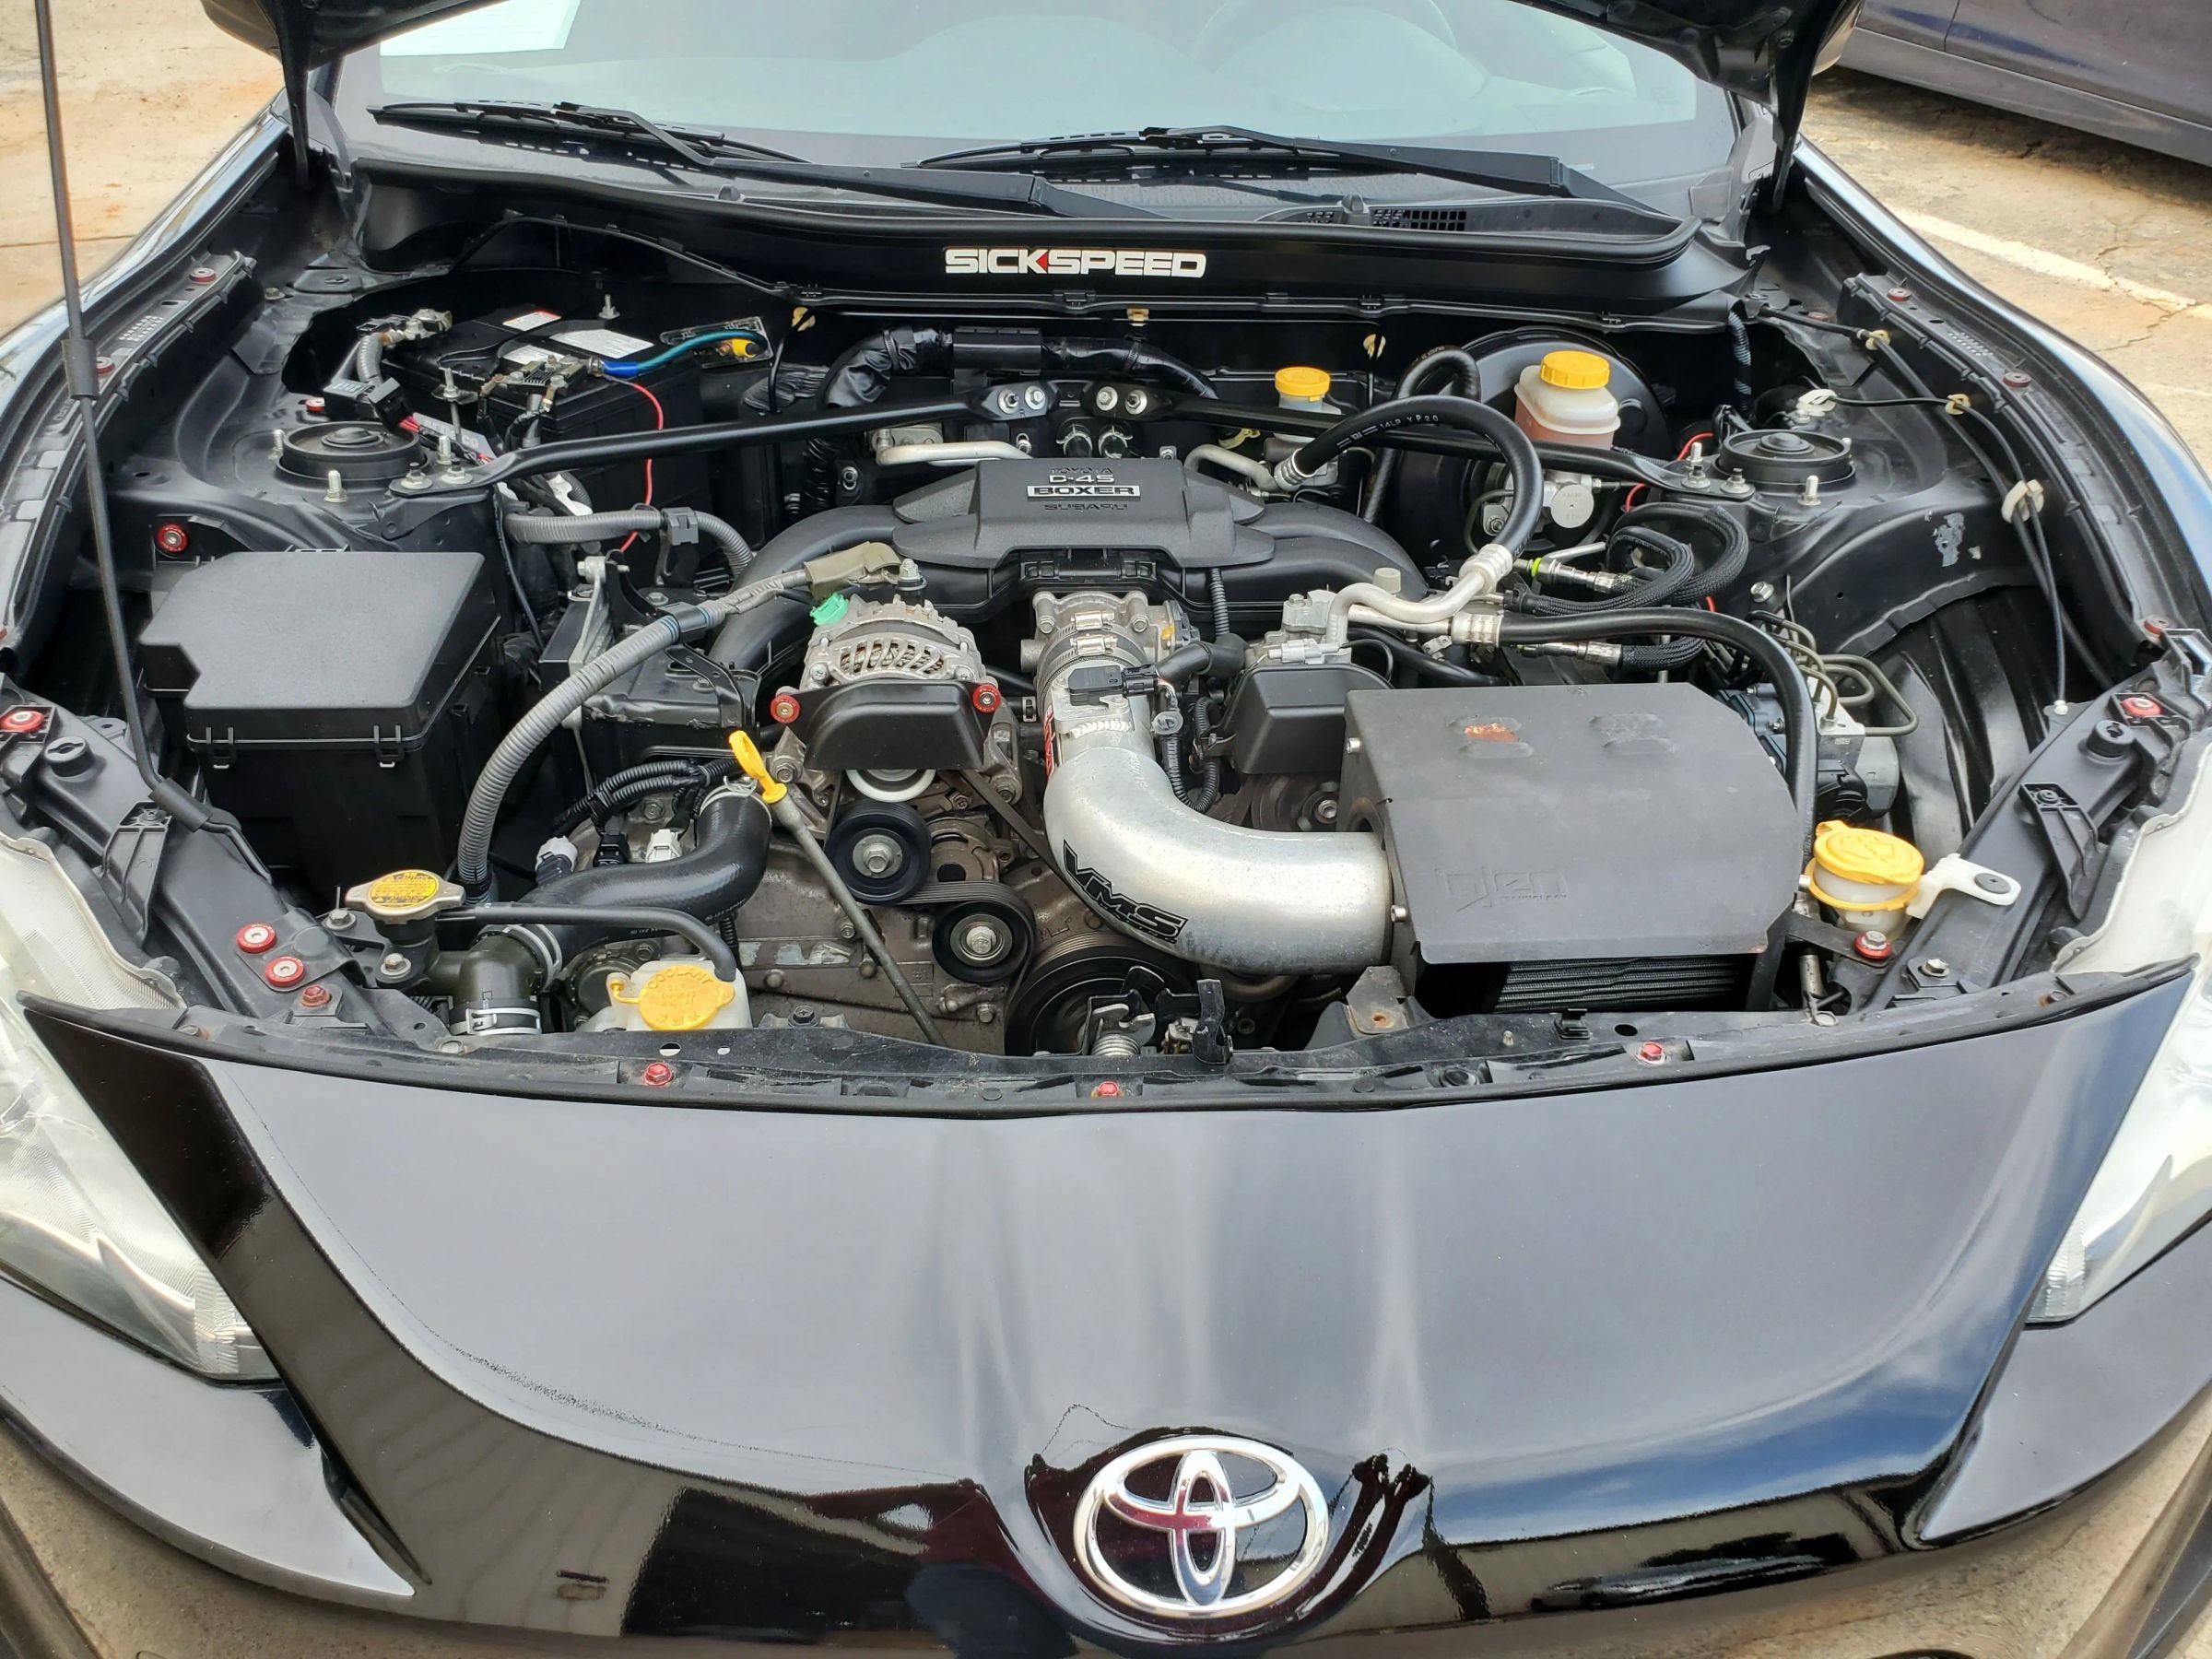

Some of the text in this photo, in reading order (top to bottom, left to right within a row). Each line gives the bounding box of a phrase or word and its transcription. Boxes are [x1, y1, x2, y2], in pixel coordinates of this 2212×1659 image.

[946, 249, 1207, 278] SICKSPEED
[1049, 474, 1114, 484] D-4S
[1033, 487, 1135, 495] BOXER
[1063, 838, 1189, 940] VMS
